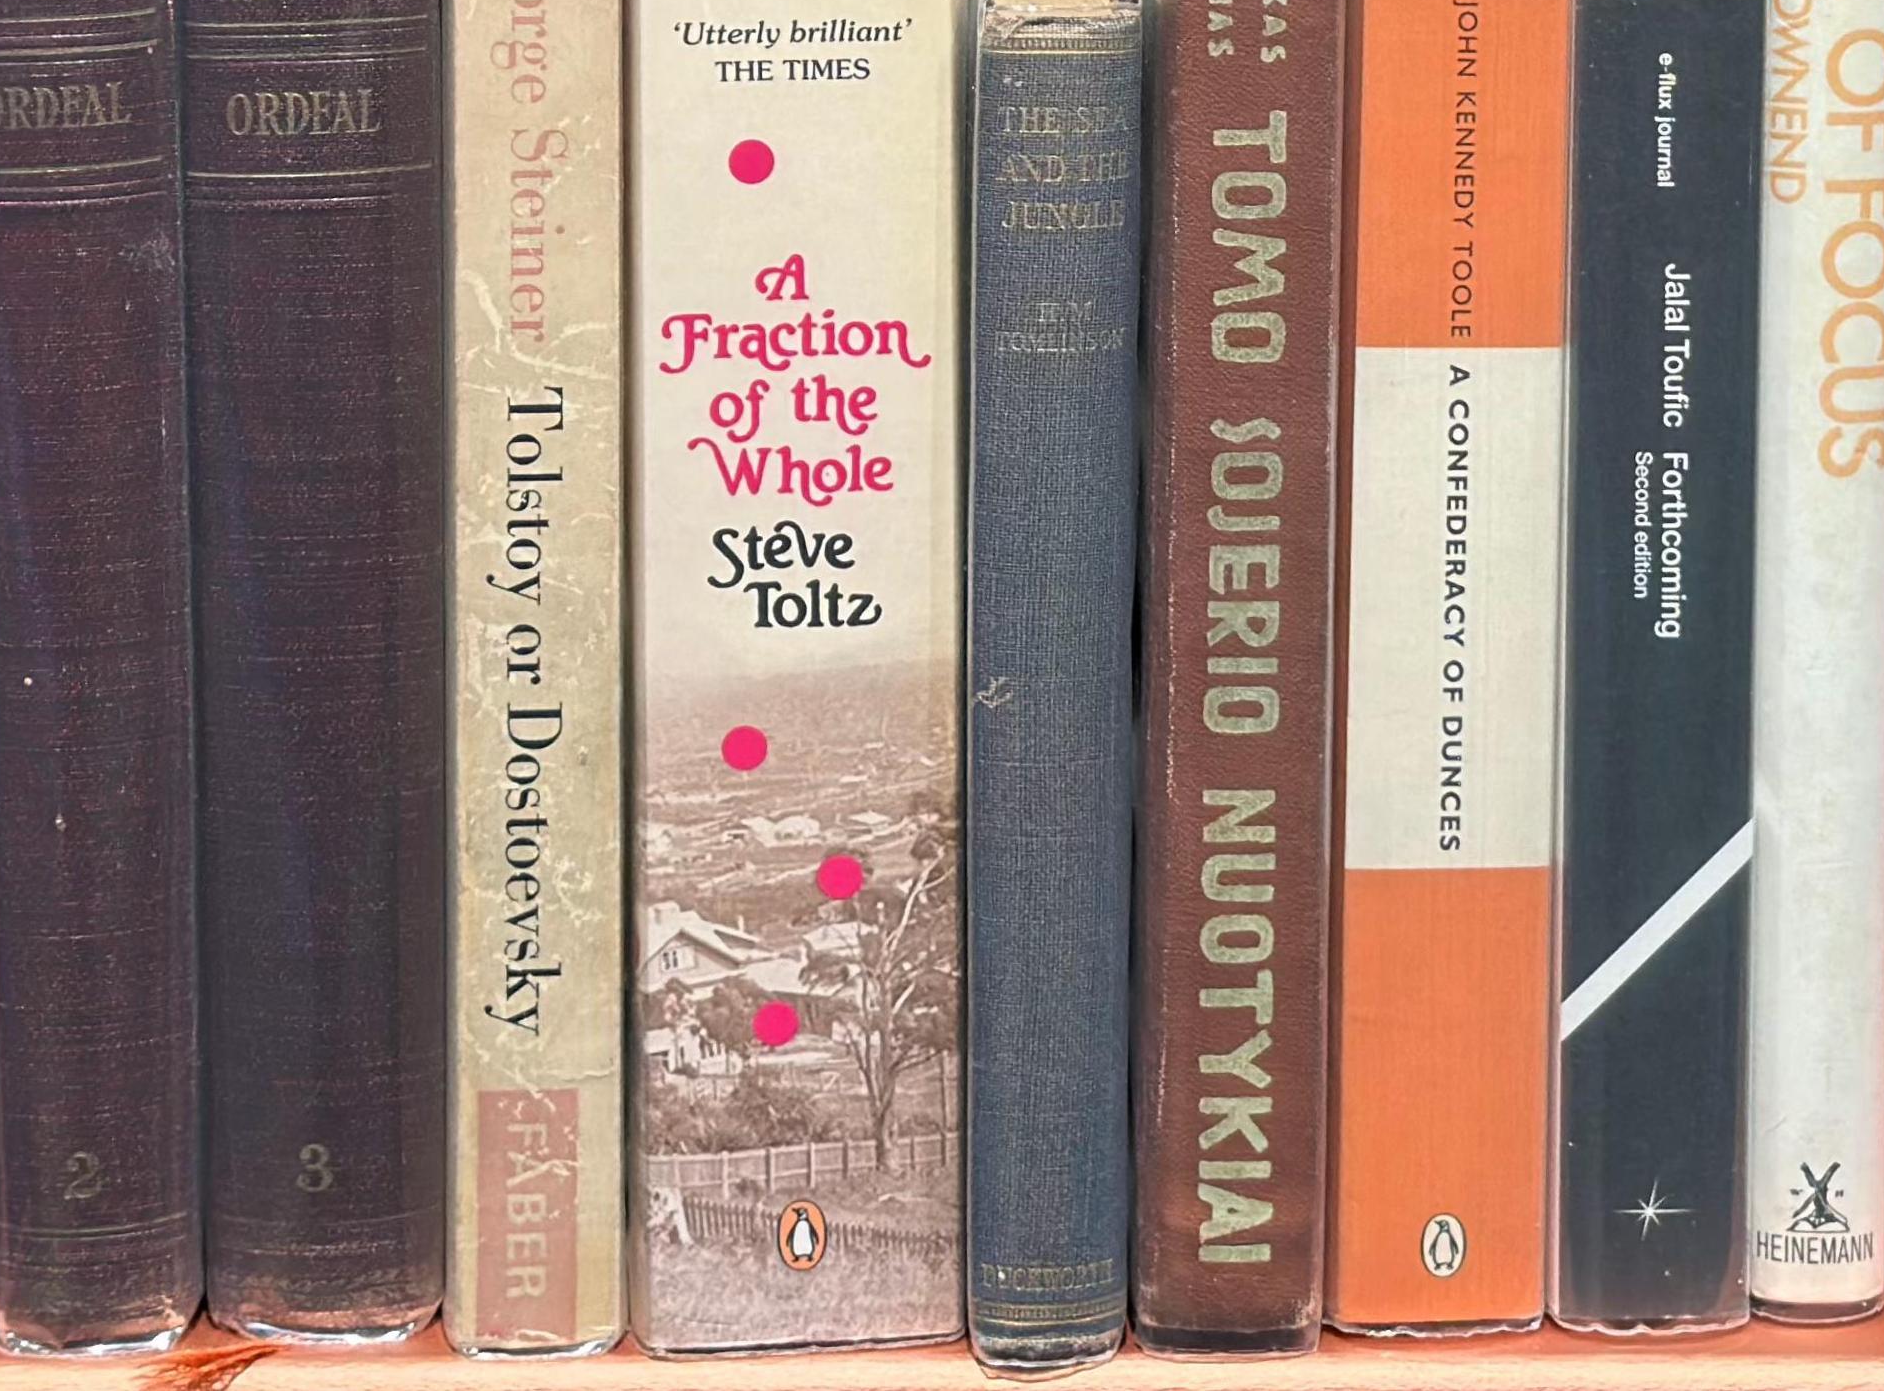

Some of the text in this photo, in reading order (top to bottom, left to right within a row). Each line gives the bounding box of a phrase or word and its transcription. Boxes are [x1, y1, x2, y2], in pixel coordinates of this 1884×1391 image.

[715, 58, 871, 83] THE TIMES
[226, 88, 381, 136] ORDEAL
[1000, 107, 1060, 134] THE
[1654, 53, 1675, 188] e-flux journal
[995, 151, 1130, 183] AND THE
[509, 127, 570, 345] Steiner
[1002, 199, 1125, 230] JUNGLE
[754, 254, 809, 302] A
[659, 309, 932, 375] Fraction
[709, 374, 879, 442] of the
[1439, 0, 1479, 852] JOHN KENNEDY TOOLE A CONFEDERACY OF DUNCES
[687, 437, 894, 506] Whole
[1653, 262, 1692, 640] Jalal Toufic Forthcoming
[707, 519, 857, 587] Steve
[1633, 451, 1654, 599] Second edition
[744, 578, 882, 629] Toltz
[485, 386, 564, 1038] Tolstoy or Dostoevsky
[1196, 110, 1289, 1264] TOMO SOJERIO NUOTYKIAI
[63, 1151, 107, 1200] 2
[296, 1143, 333, 1193] 3
[505, 1121, 548, 1301] FABER
[1756, 1230, 1874, 1265] HEINEMANN
